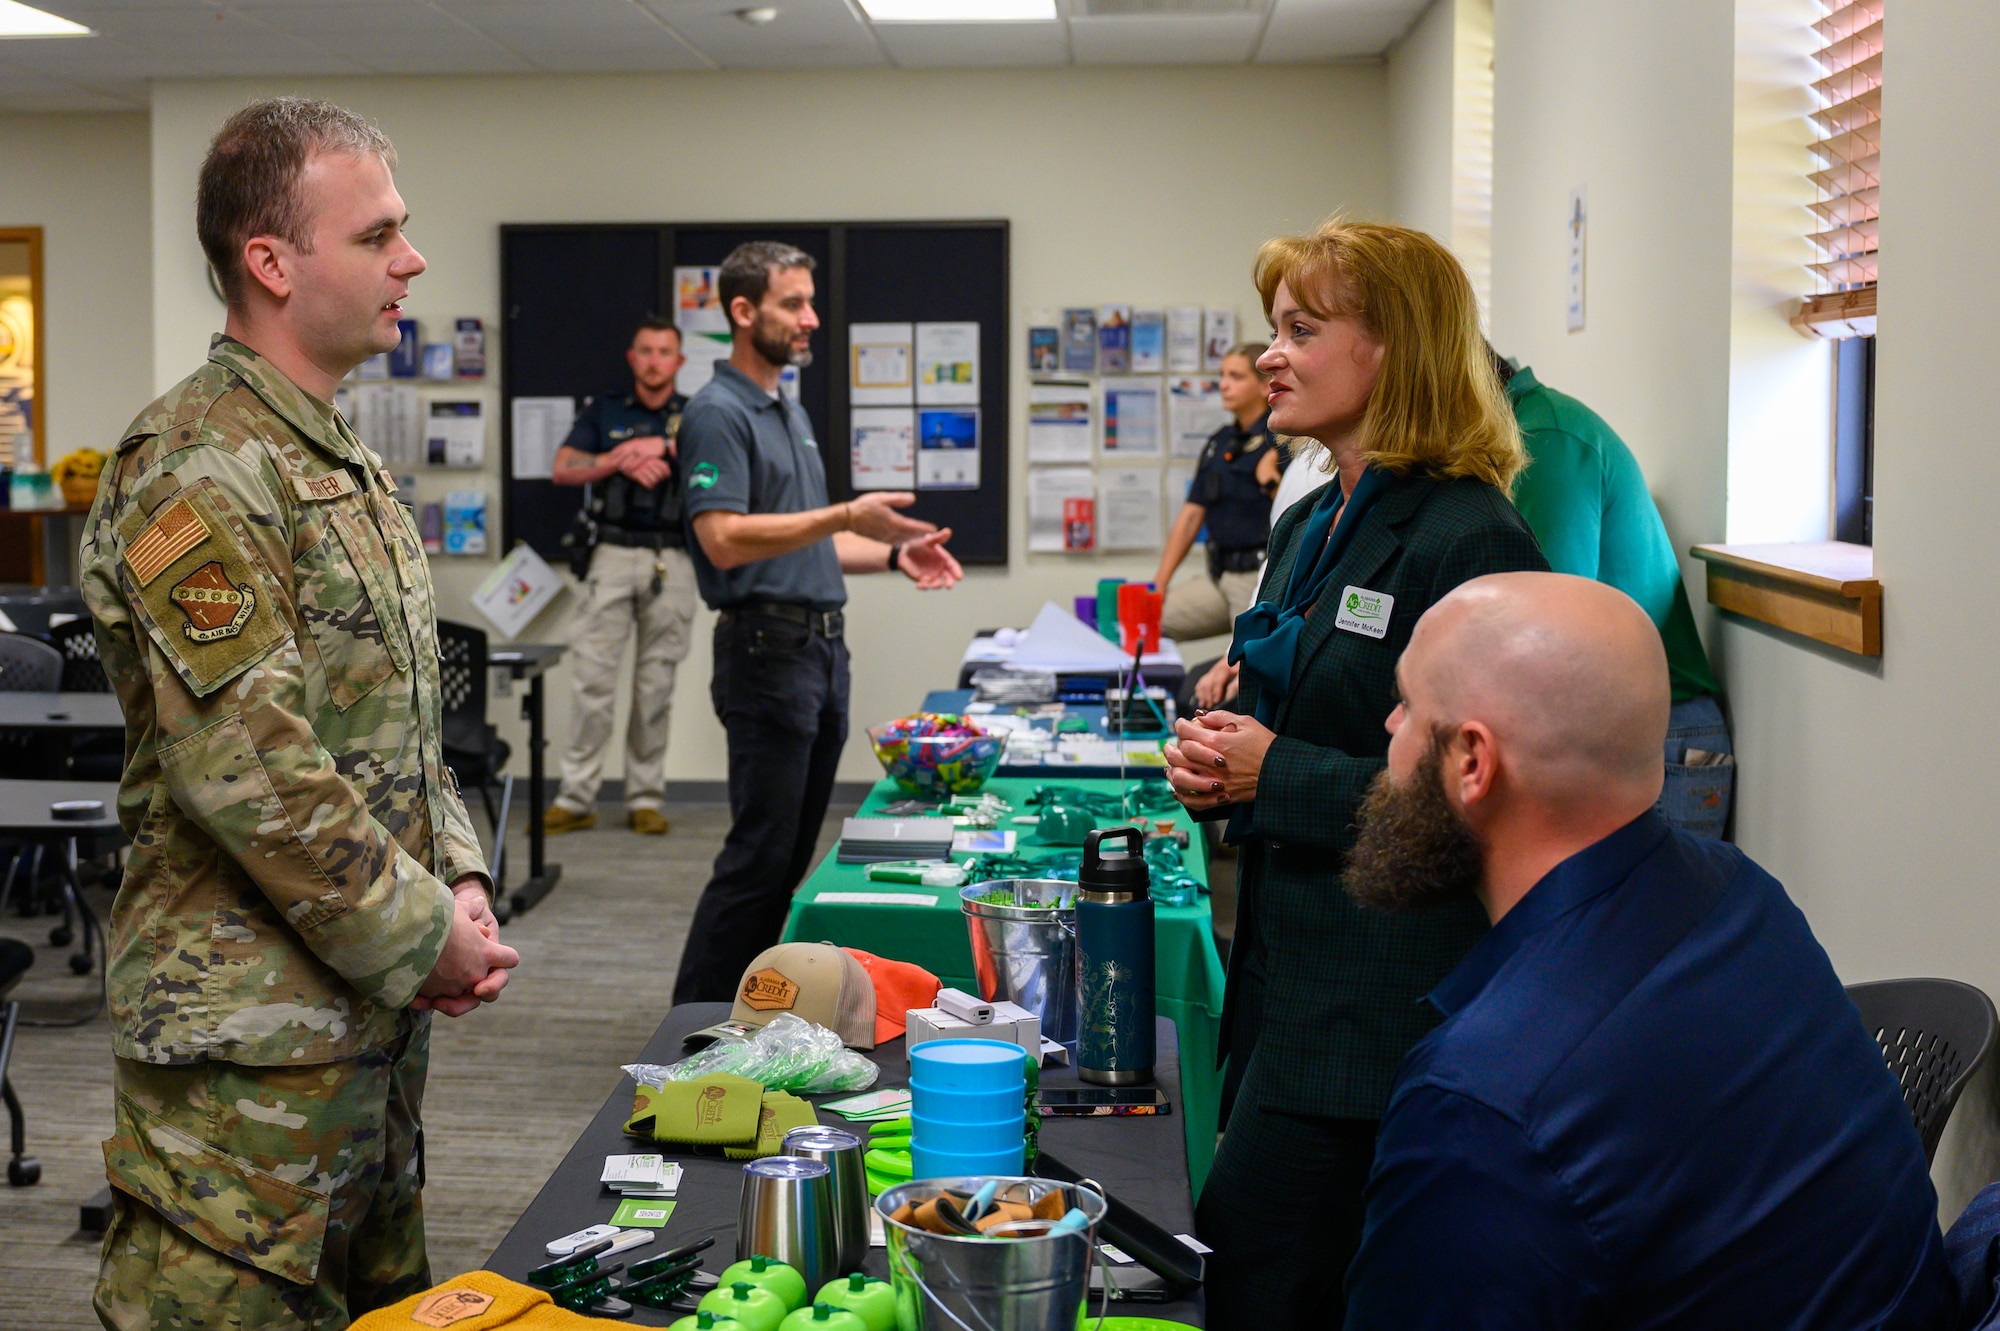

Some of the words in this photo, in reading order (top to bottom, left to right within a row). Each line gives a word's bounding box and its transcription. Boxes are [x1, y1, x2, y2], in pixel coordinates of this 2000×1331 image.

[1359, 600, 1382, 613] CREDIT
[211, 629, 225, 638] AIR
[238, 600, 254, 619] WING
[1338, 618, 1360, 628] Jennifer
[757, 981, 790, 997] CREDIT
[704, 1100, 718, 1125] CREDIT
